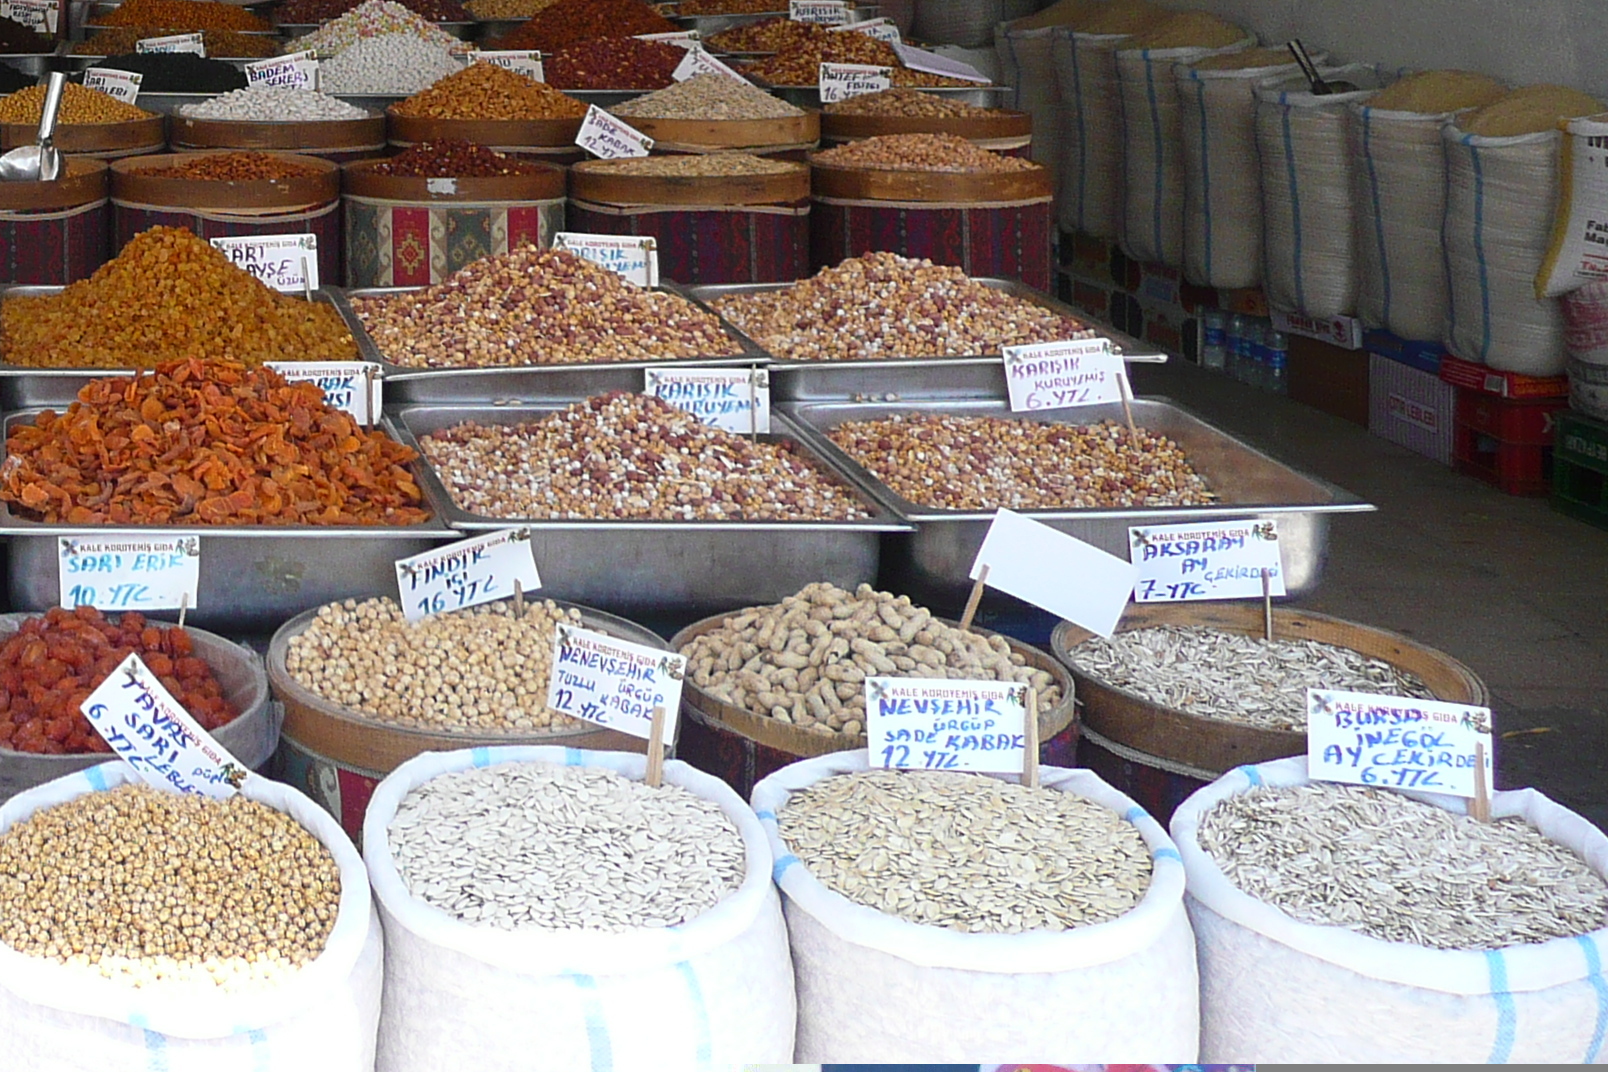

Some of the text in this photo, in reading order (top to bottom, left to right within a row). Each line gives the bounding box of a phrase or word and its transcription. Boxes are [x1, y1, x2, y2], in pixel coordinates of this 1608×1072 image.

[1011, 357, 1080, 380] KARIŞIK
[655, 382, 739, 401] KARIŞIK
[1143, 536, 1245, 562] AKSARAY
[69, 553, 122, 574] SARI
[1181, 558, 1208, 575] AY
[418, 589, 446, 614] 16
[555, 690, 573, 711] 12
[88, 703, 108, 720] 6
[125, 713, 180, 764] SARI
[882, 744, 911, 768] 12
[1325, 746, 1360, 766] AY
